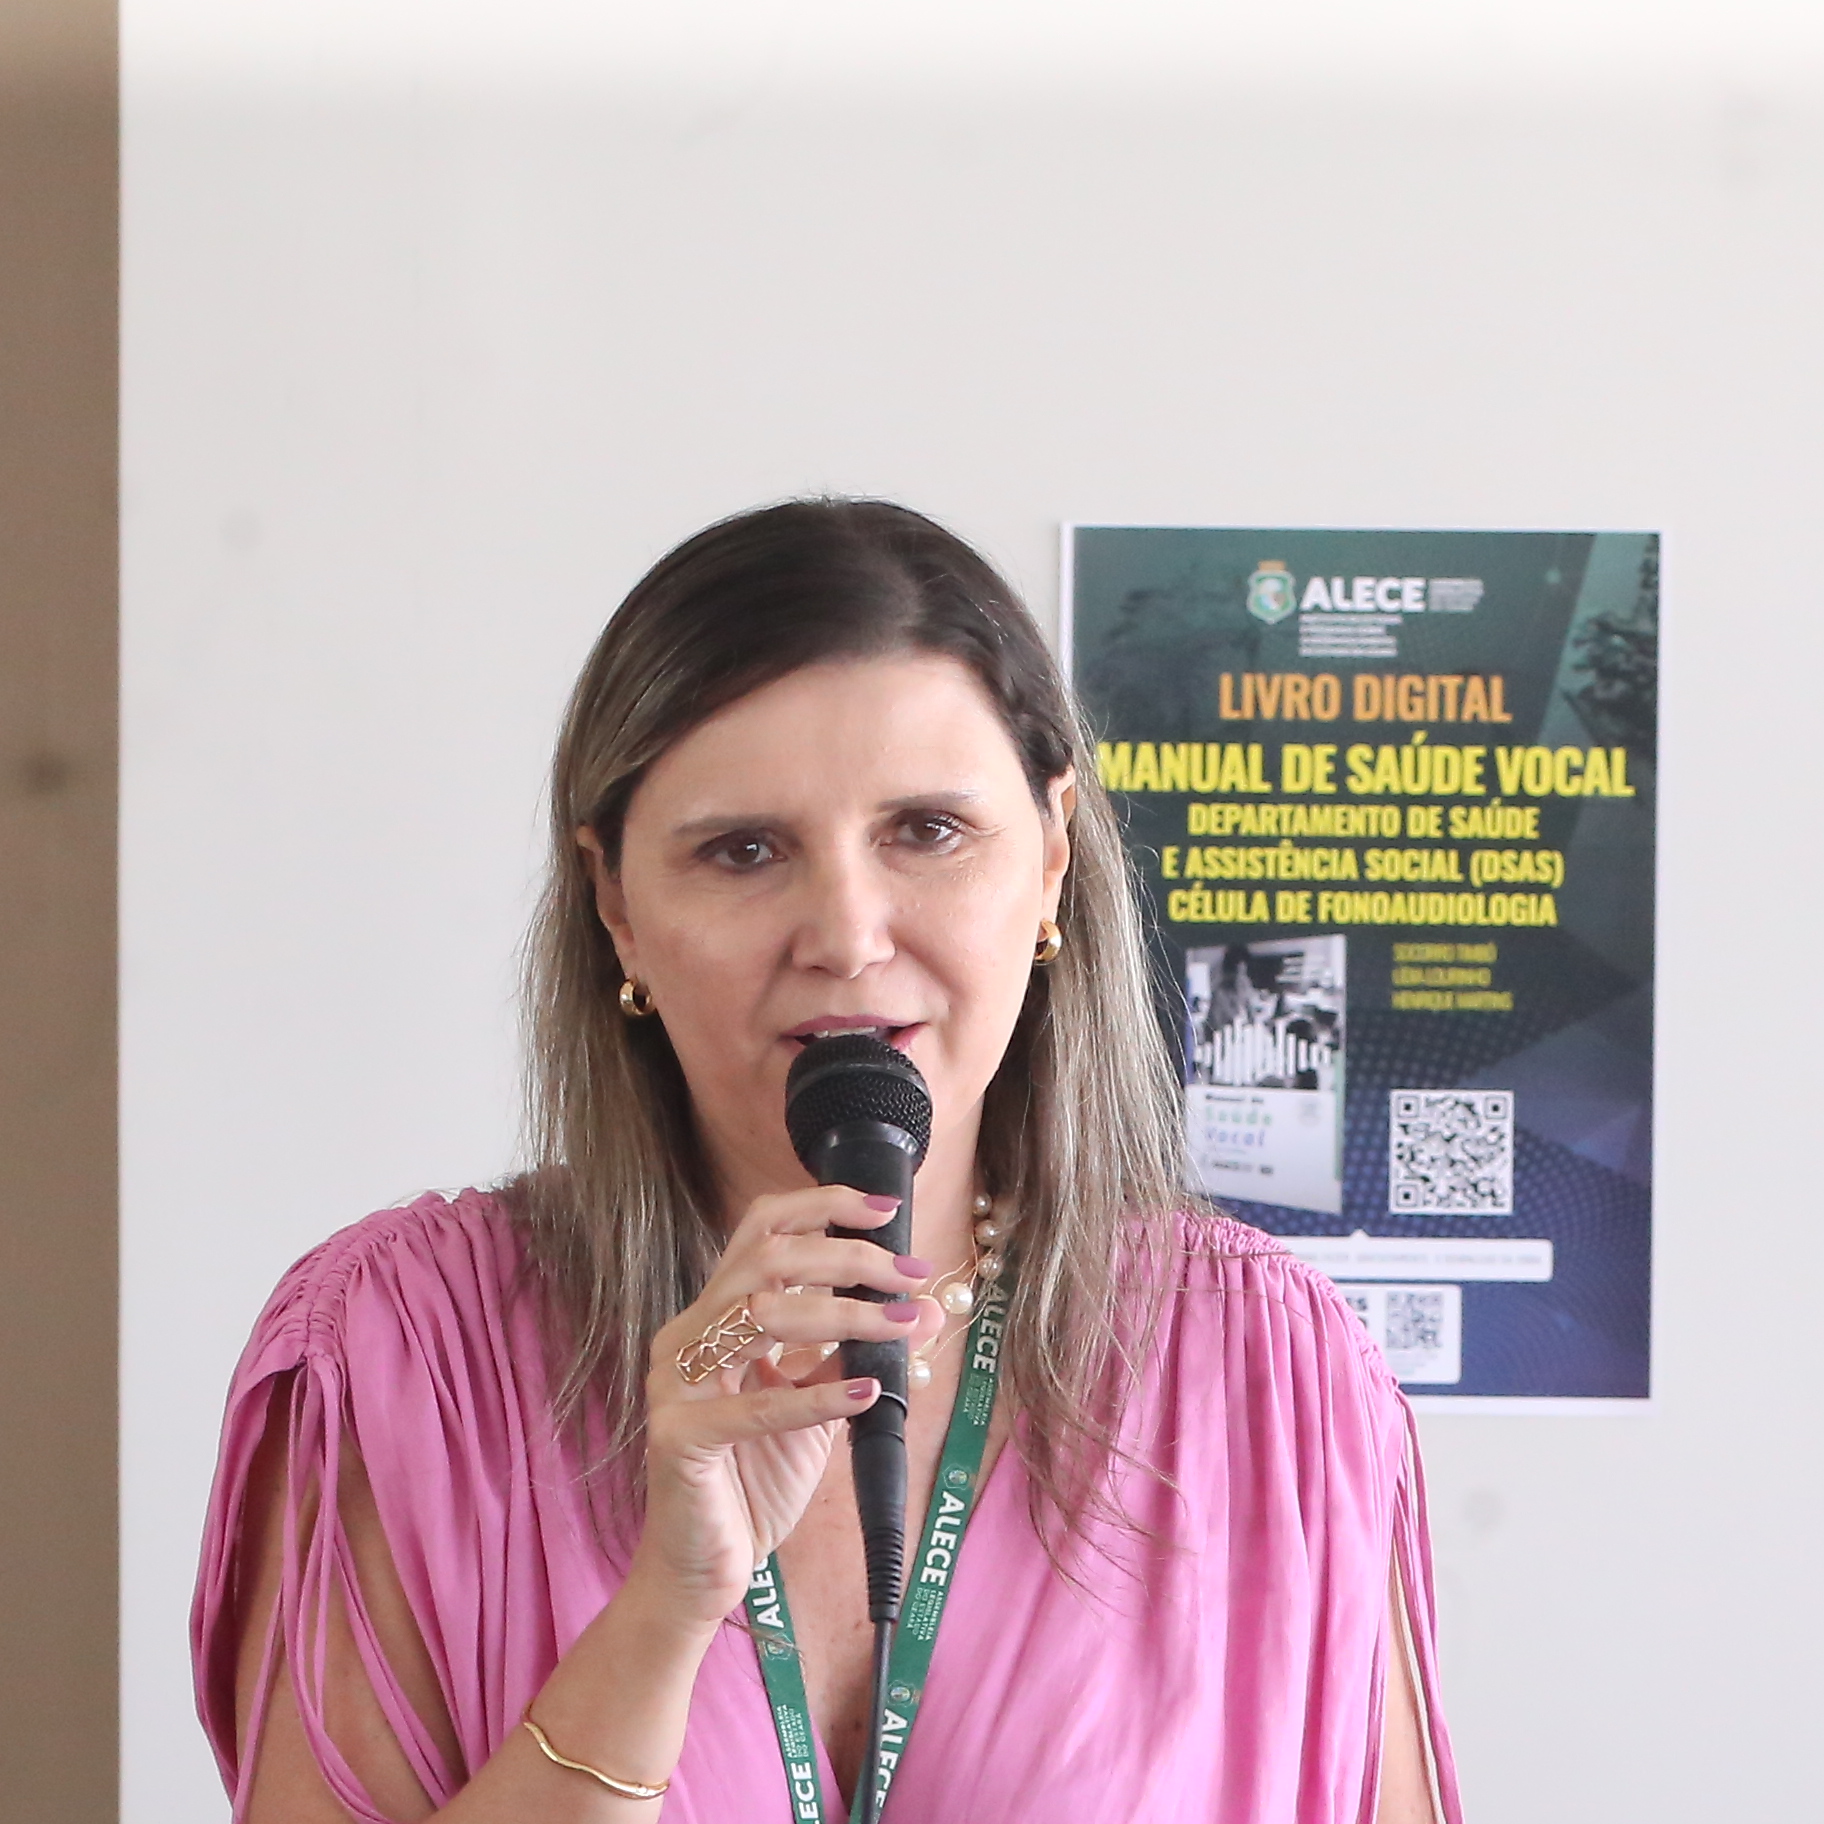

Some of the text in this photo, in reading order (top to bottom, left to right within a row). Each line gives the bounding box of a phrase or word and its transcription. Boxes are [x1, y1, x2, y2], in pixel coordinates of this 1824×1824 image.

[1299, 576, 1426, 613] ALECE
[1219, 673, 1513, 723] LIVRO DIGITAL
[1097, 732, 1635, 797] MANUAL DE SAÚDE VOCAL
[1188, 798, 1539, 839] DEPARTAMENTO DE SAÚDE
[1162, 840, 1565, 889] E ASSISTÊNCIA SOCIAL (DSAS)
[1168, 883, 1557, 926] CÉLULA DE FONOAUDIOLOGIA
[973, 1281, 1008, 1373] ALECE
[921, 1491, 965, 1587] ALECE
[750, 1557, 785, 1628] ALE
